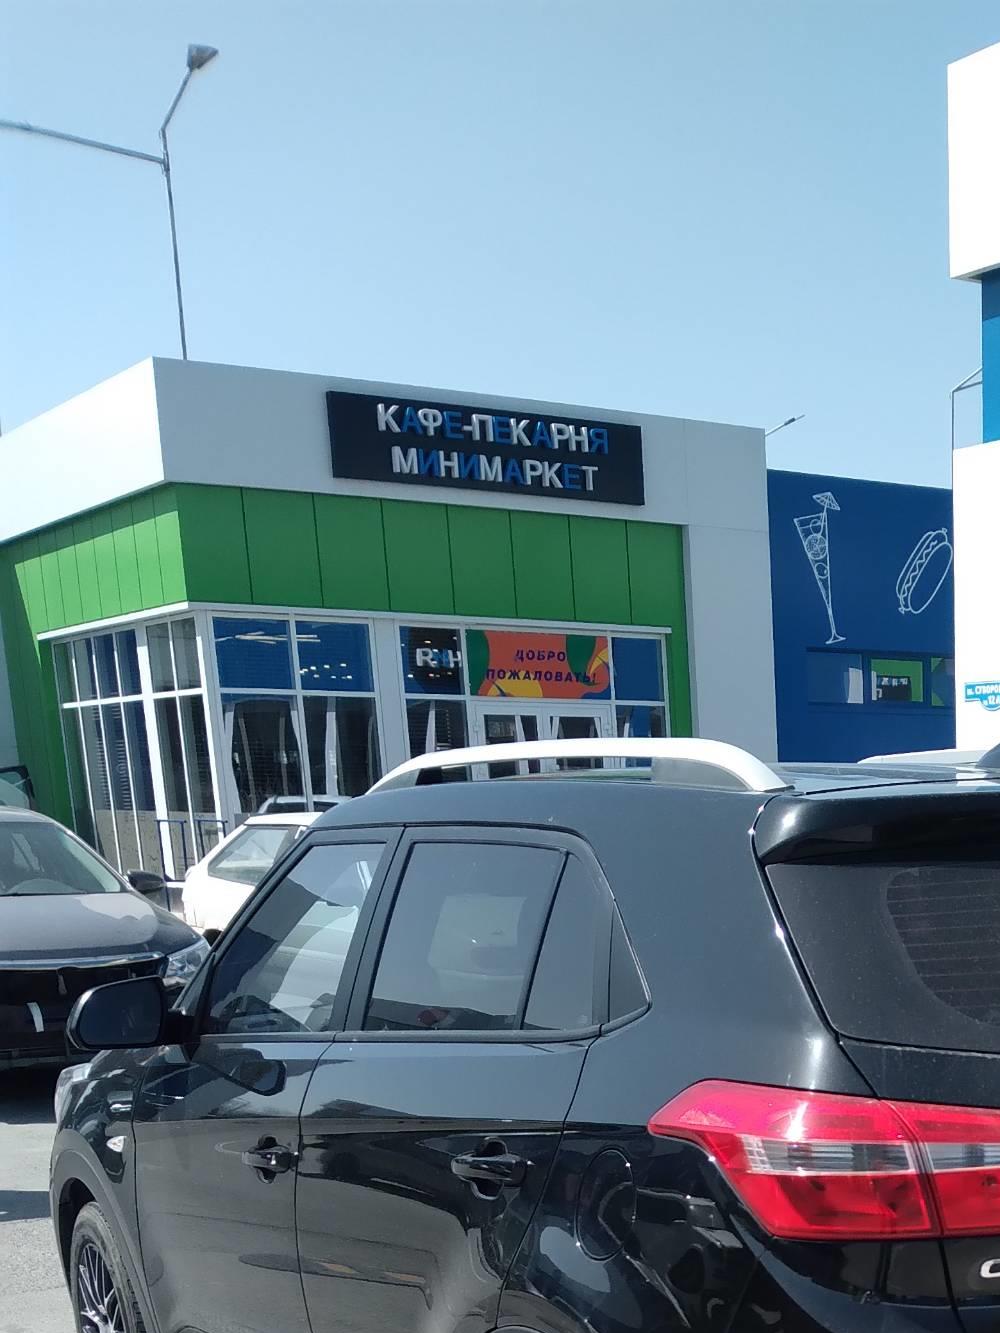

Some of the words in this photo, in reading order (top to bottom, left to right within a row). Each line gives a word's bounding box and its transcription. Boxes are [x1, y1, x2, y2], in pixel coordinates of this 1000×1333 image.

[376, 402, 609, 455] КАФЕ-ПЕКАРНЯ
[391, 446, 599, 491] МИНИМАРКЕТ
[514, 649, 566, 662] ДОБРО
[486, 668, 597, 684] ПОЖАЛОВАТЬ!
